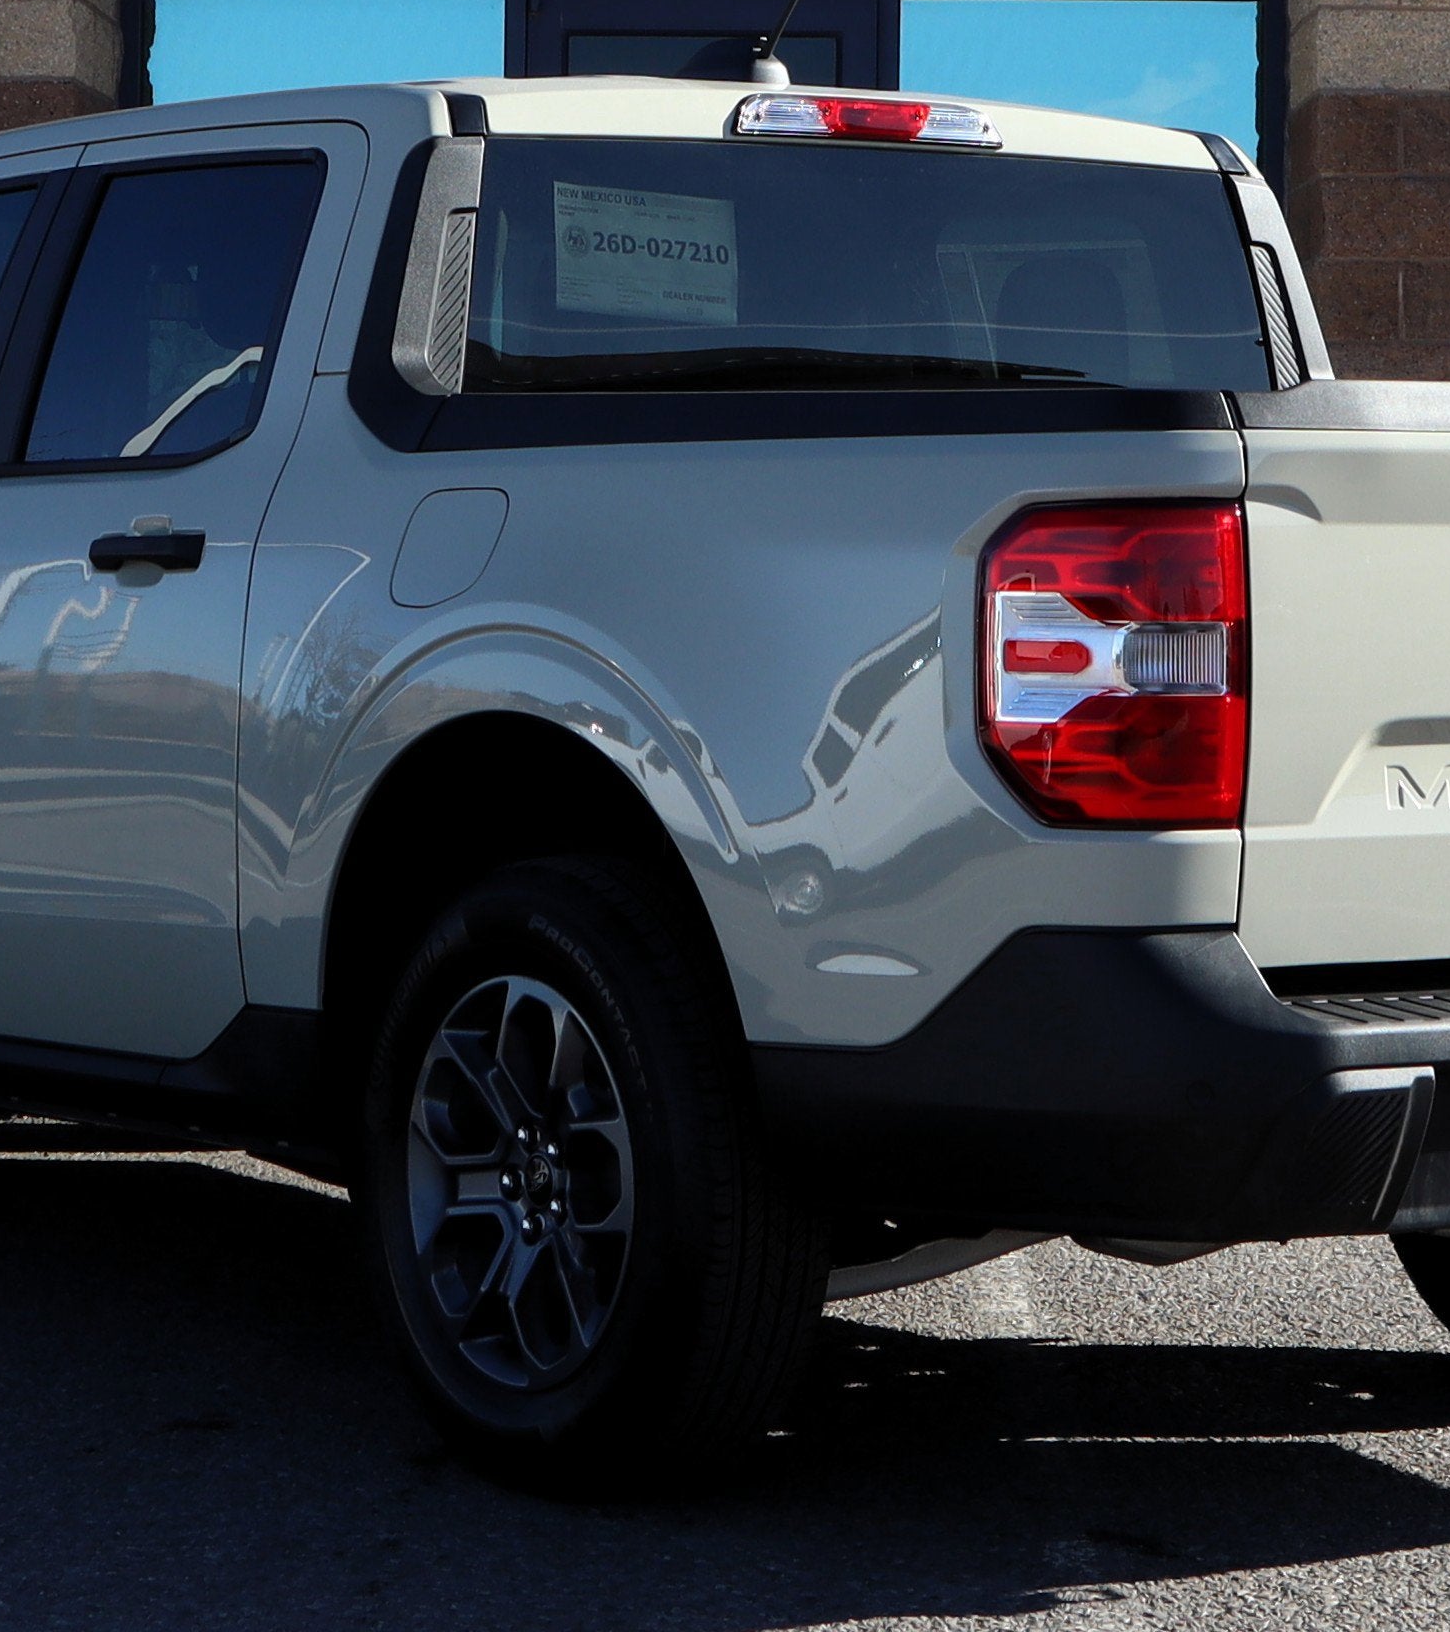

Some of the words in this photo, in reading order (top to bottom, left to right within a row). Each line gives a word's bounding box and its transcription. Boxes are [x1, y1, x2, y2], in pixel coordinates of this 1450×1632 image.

[556, 186, 578, 199] NEW
[581, 190, 622, 204] MEXICO
[624, 195, 647, 207] USA
[593, 232, 729, 265] 26D-027210
